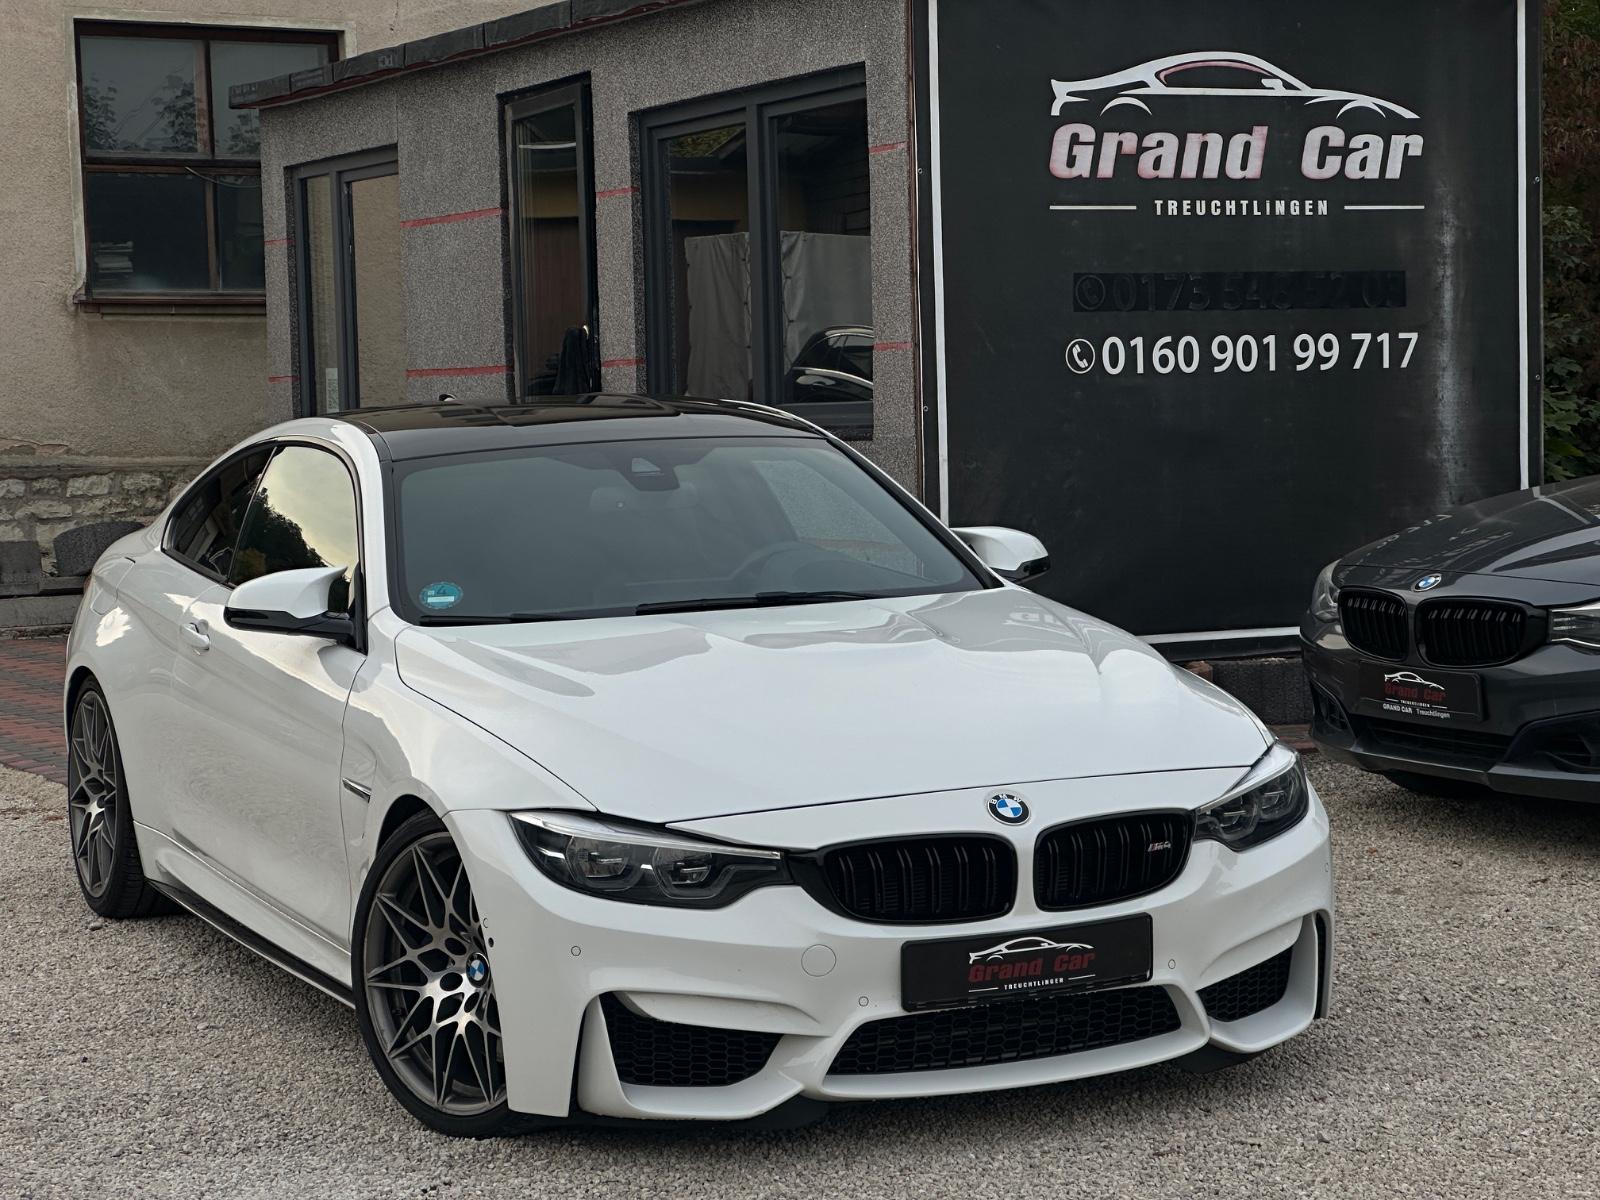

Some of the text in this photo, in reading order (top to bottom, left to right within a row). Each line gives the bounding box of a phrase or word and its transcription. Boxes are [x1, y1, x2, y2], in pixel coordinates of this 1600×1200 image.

[1048, 122, 1424, 180] Grand Car
[1102, 332, 1419, 375] 0160 901 99 717
[1382, 703, 1400, 712] GRAND
[1401, 705, 1413, 714] CAR
[968, 952, 1095, 983] Grand Car
